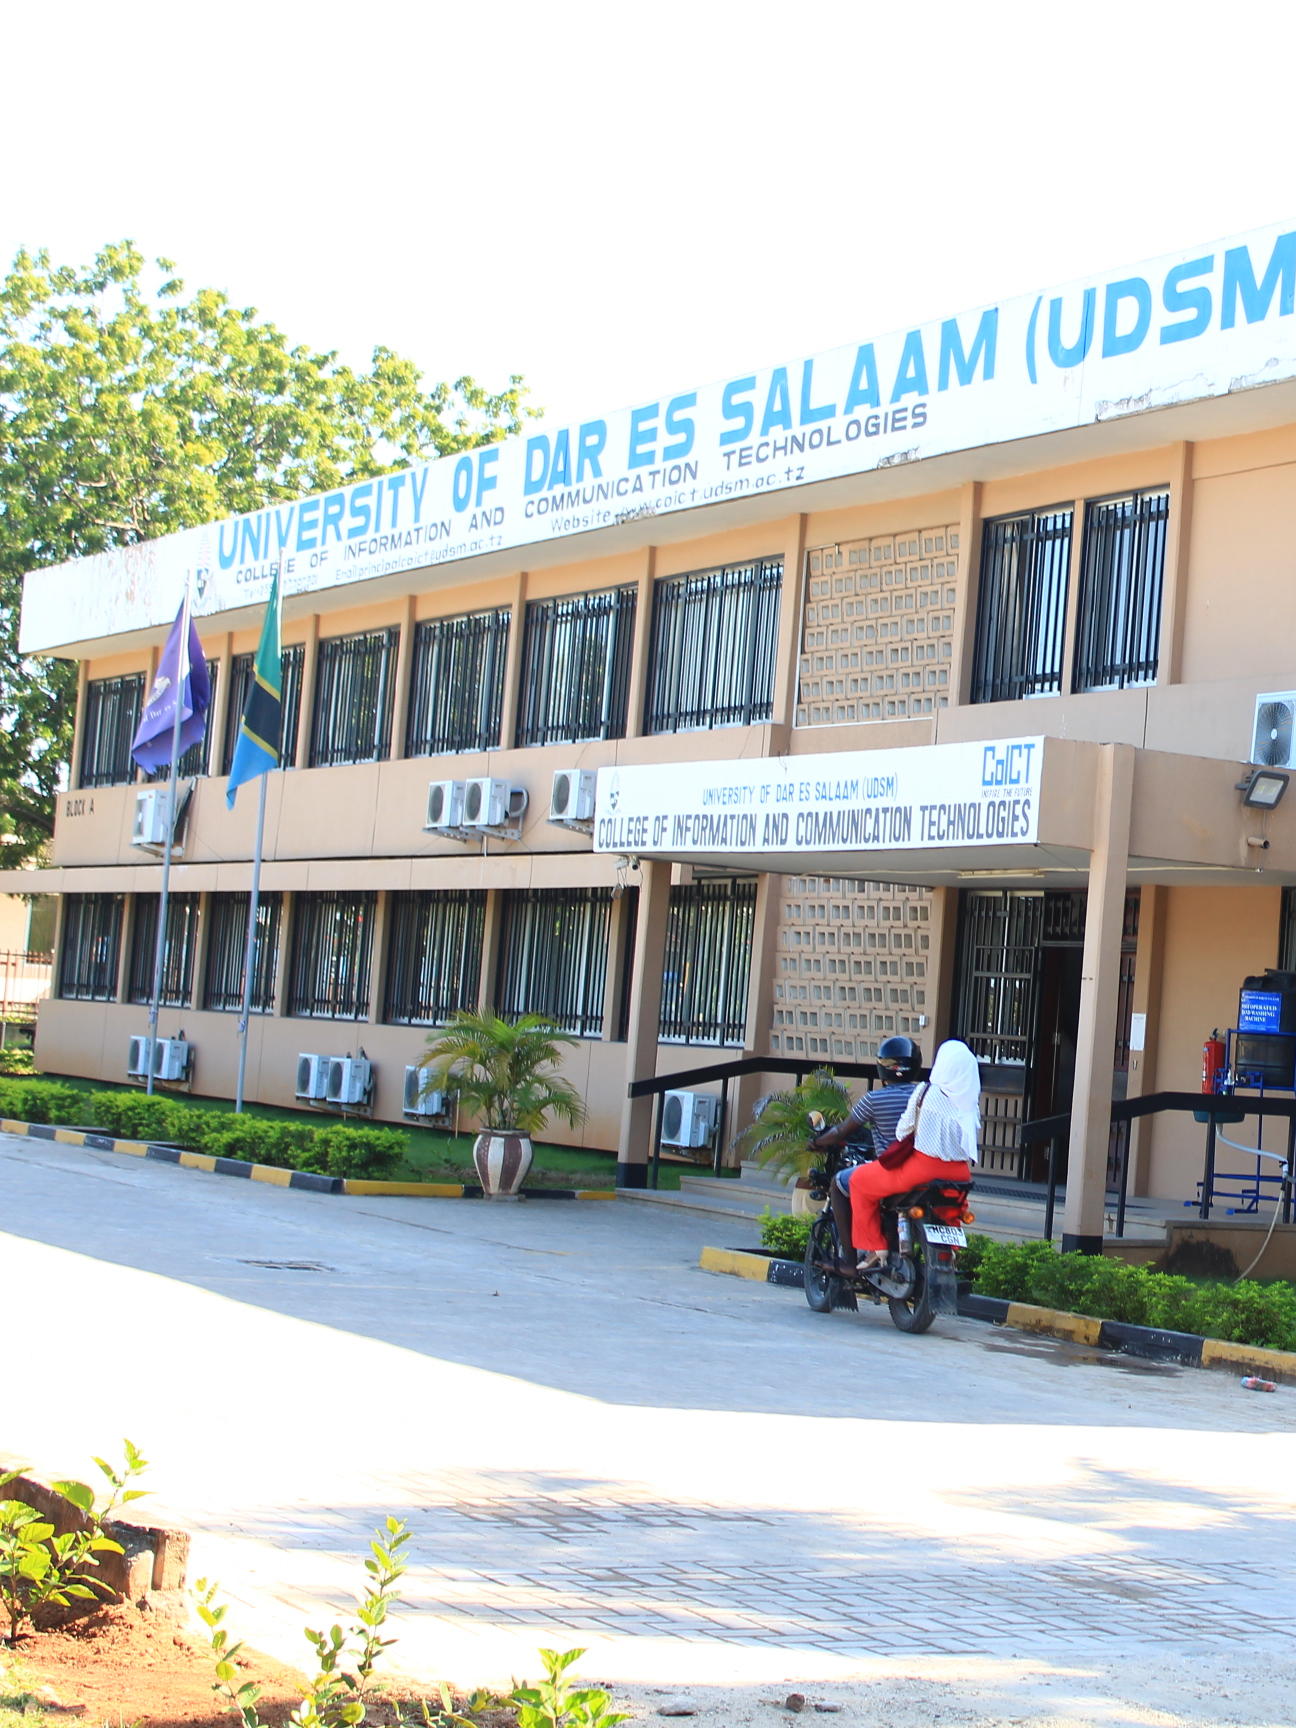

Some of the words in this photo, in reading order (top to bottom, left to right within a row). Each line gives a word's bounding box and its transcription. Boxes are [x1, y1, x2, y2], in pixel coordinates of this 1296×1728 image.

[219, 467, 429, 570] UNIVERSITY
[454, 447, 499, 514] OF
[523, 419, 607, 497] DAR
[627, 391, 697, 469] ES
[719, 307, 999, 446] SALAAM
[236, 557, 296, 585] COLLEE
[310, 550, 329, 569] OF
[344, 518, 451, 560] INFORMATION
[468, 507, 505, 533] AND
[524, 460, 699, 520] COMMUNICATION
[722, 403, 929, 472] TECHNOLOGIES
[982, 743, 1035, 786] CoICT
[66, 799, 85, 817] BLOCK
[89, 798, 95, 815] A
[703, 786, 755, 806] UNIVERSITY
[760, 784, 771, 804] OF
[776, 783, 795, 803] DAR
[799, 782, 811, 802] ES
[815, 779, 859, 801] SALAAM
[862, 772, 898, 801] (UDSM)
[598, 816, 649, 848] COLLEGE
[652, 815, 668, 847] OF
[672, 813, 757, 847] INFORMATION
[762, 812, 789, 847] AND
[795, 805, 912, 846] COMMUNICATION
[919, 798, 1031, 841] TECHNOLOGIES
